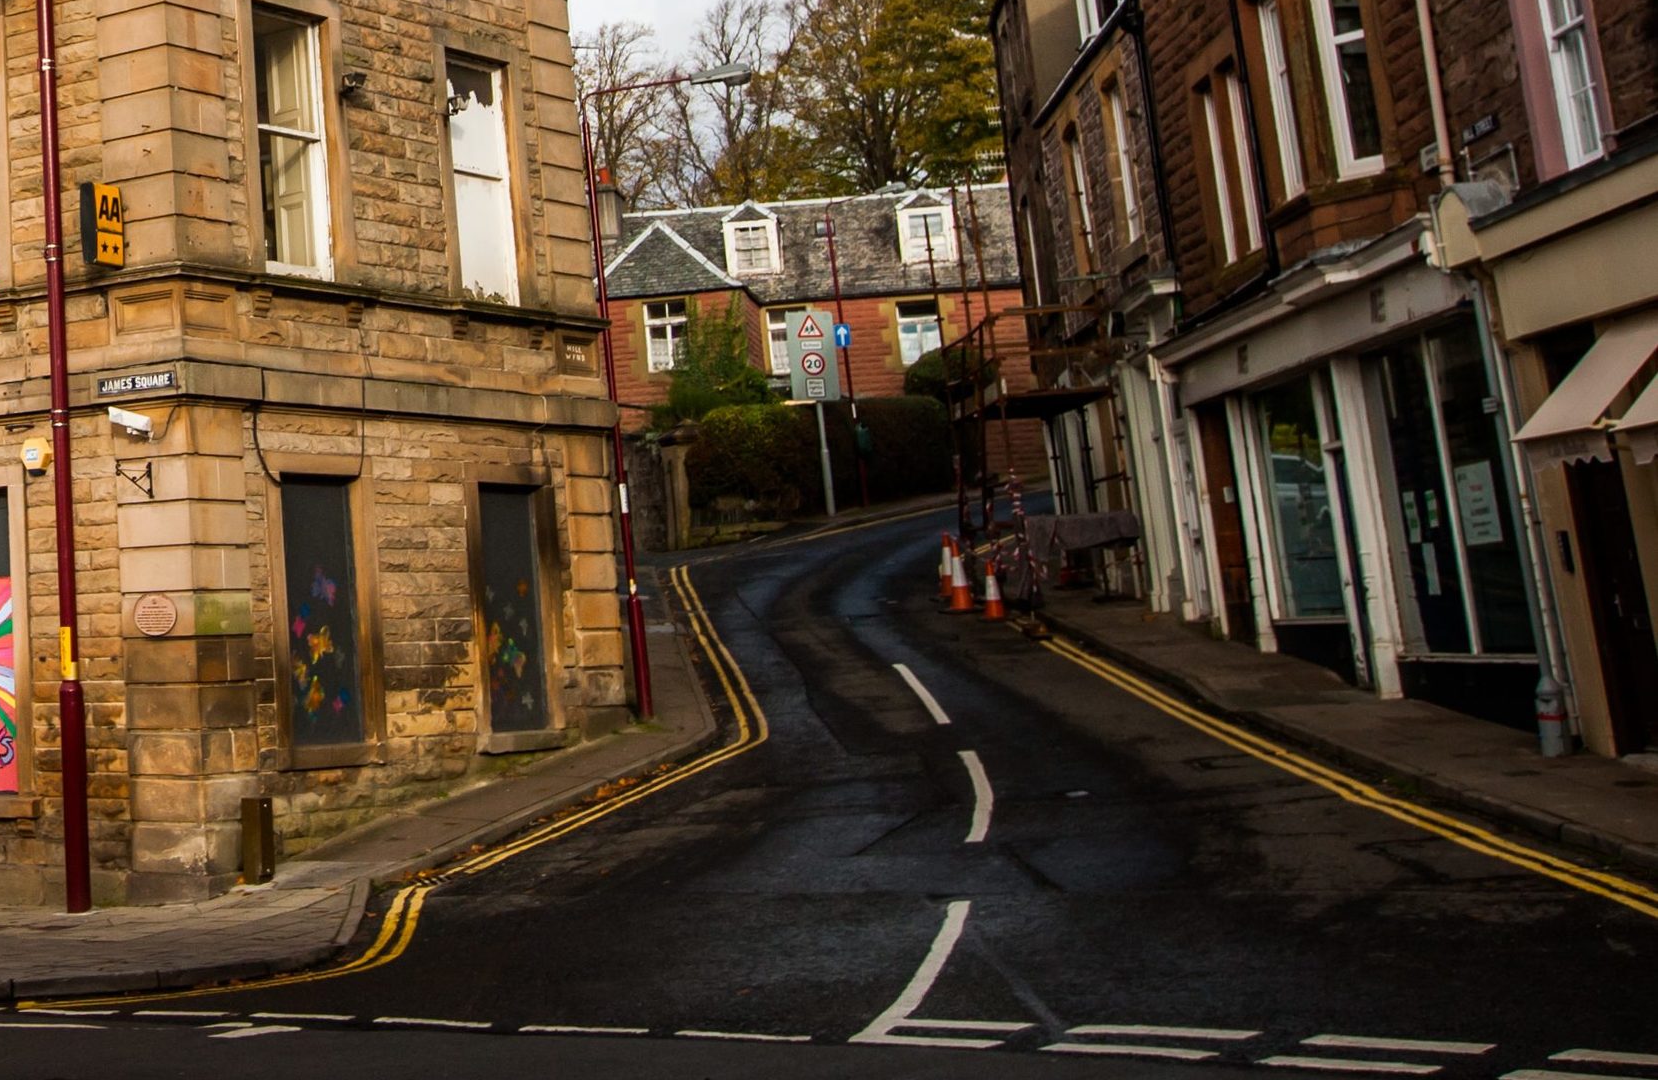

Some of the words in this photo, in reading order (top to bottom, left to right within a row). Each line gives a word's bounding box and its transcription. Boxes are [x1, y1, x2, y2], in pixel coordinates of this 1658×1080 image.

[98, 194, 121, 223] AA
[566, 344, 582, 354] HILL
[805, 358, 822, 369] 20
[102, 377, 132, 392] JAMES
[135, 373, 170, 388] SQUARE
